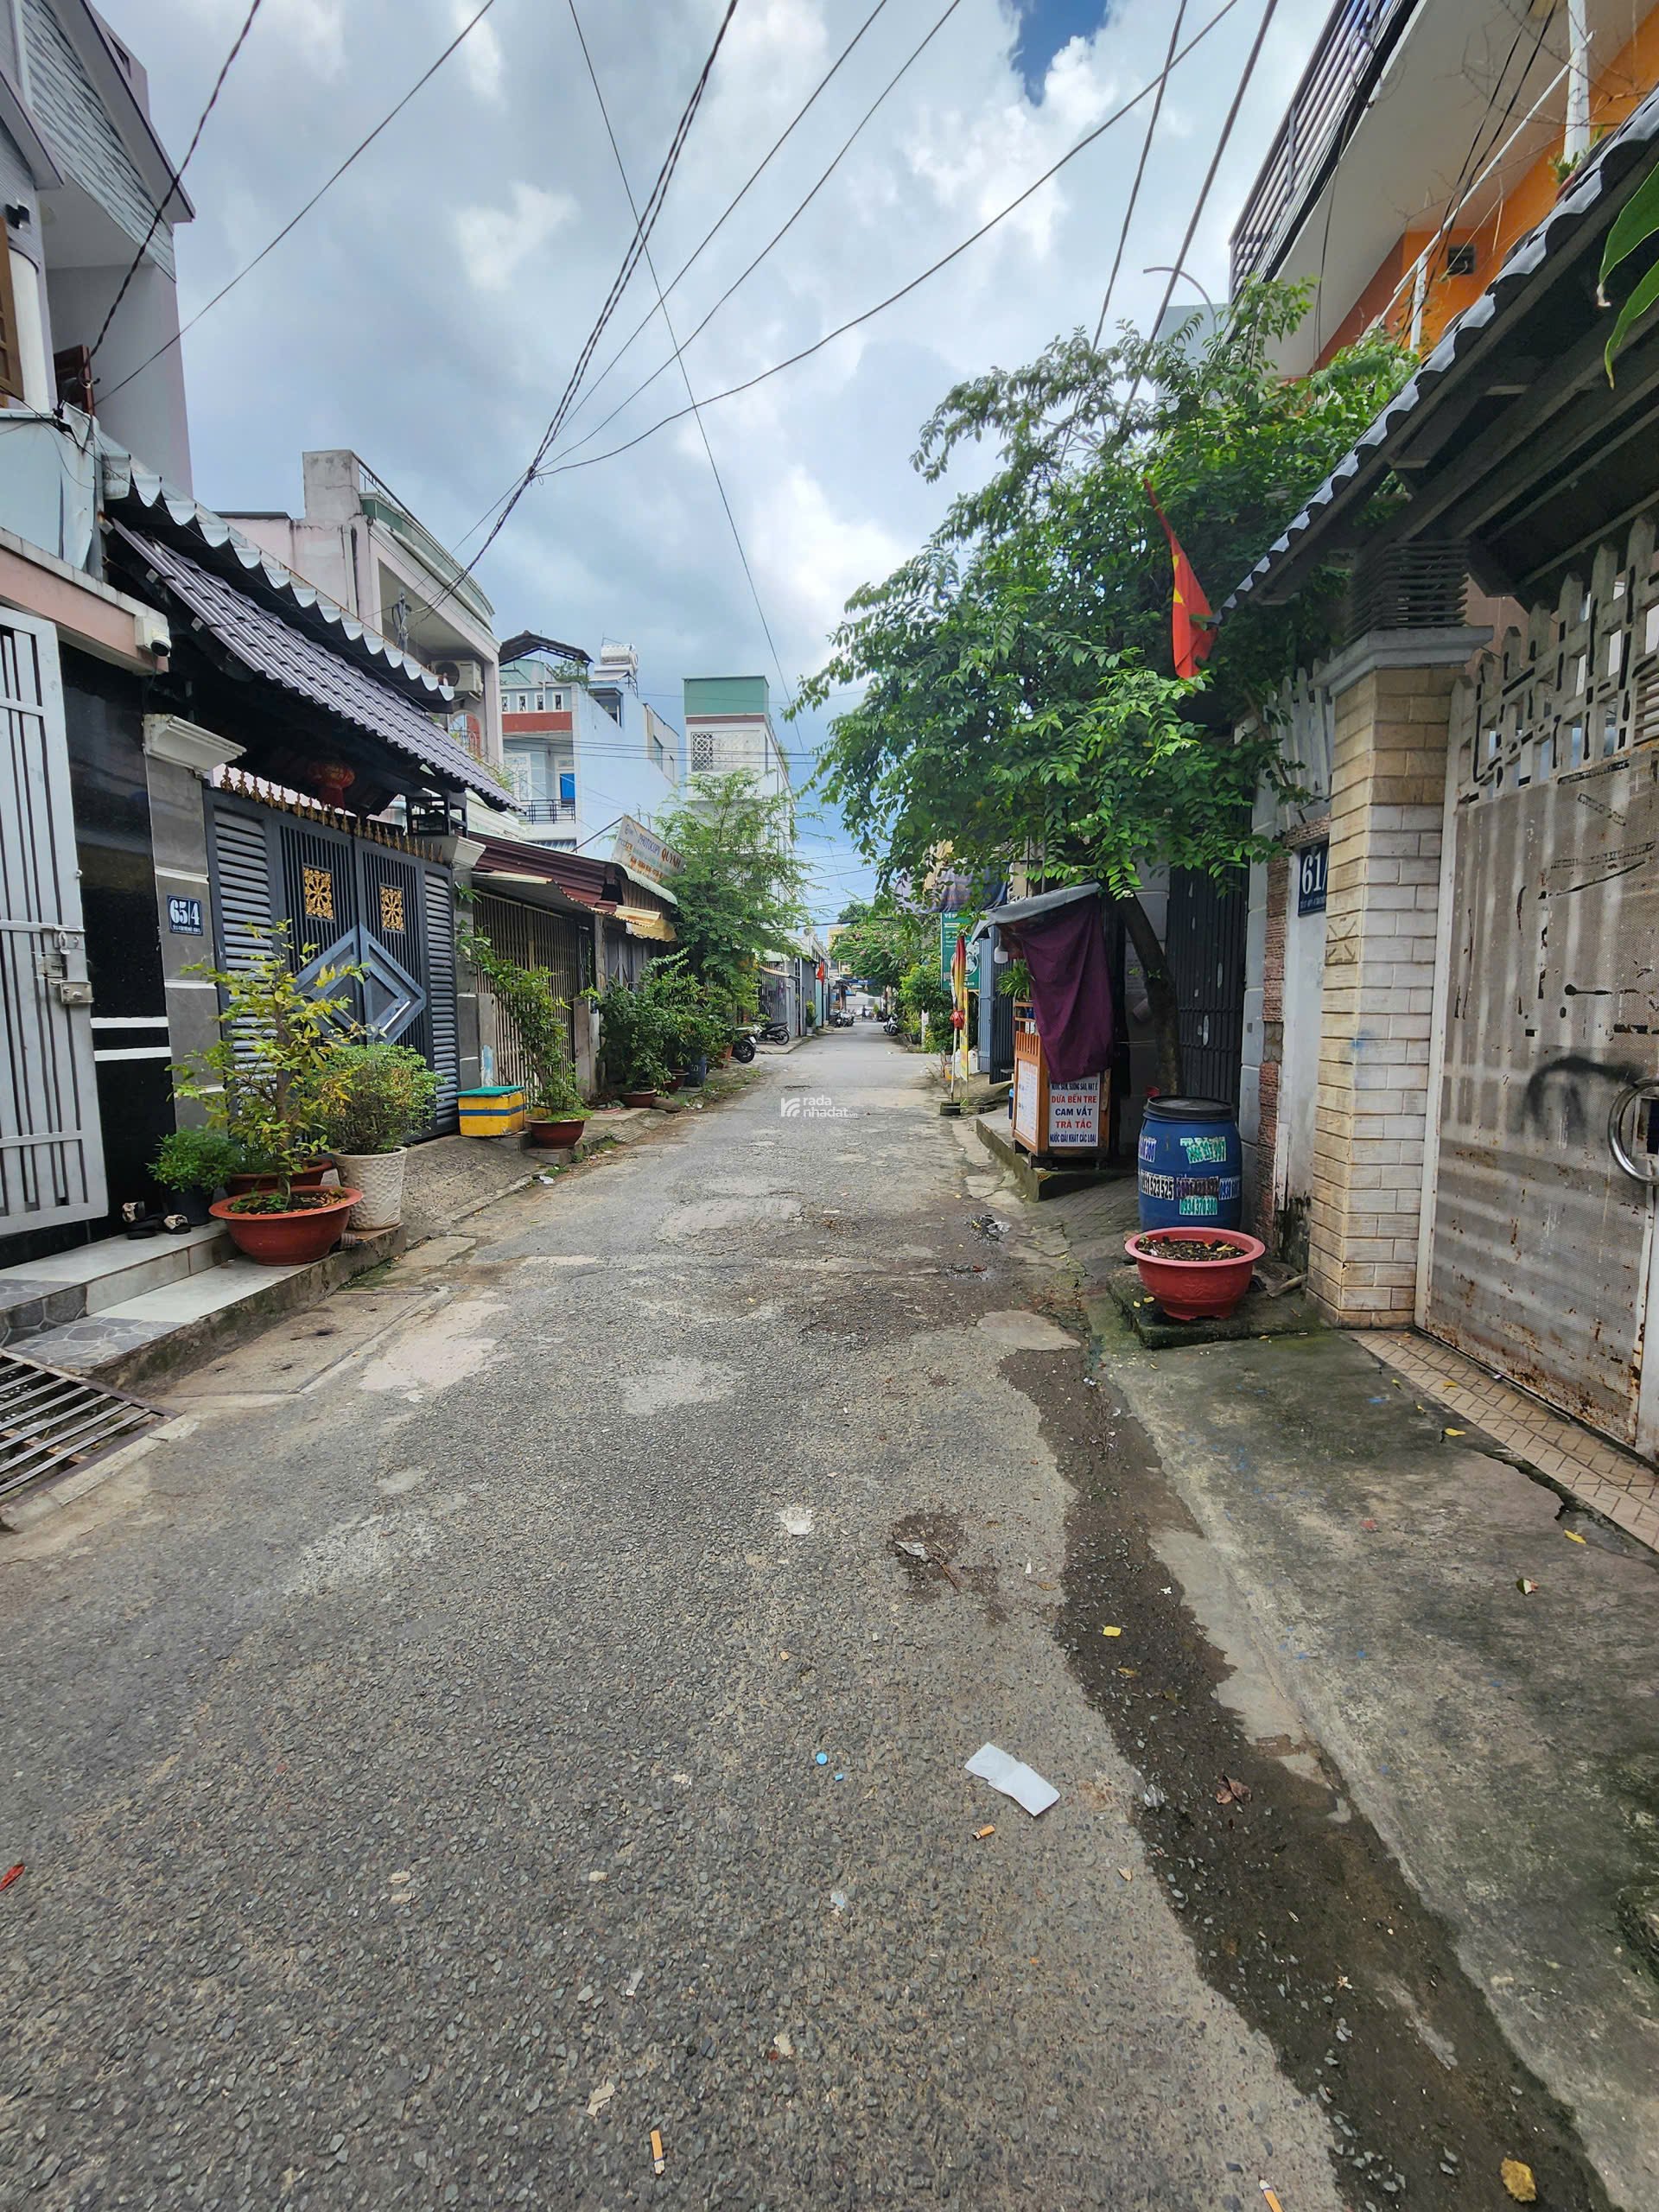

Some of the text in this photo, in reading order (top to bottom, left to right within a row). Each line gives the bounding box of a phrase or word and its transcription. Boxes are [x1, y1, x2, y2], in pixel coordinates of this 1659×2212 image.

[170, 899, 200, 925] 65/4
[1055, 1108, 1073, 1116] CAM
[1056, 1119, 1071, 1128] TRÀ
